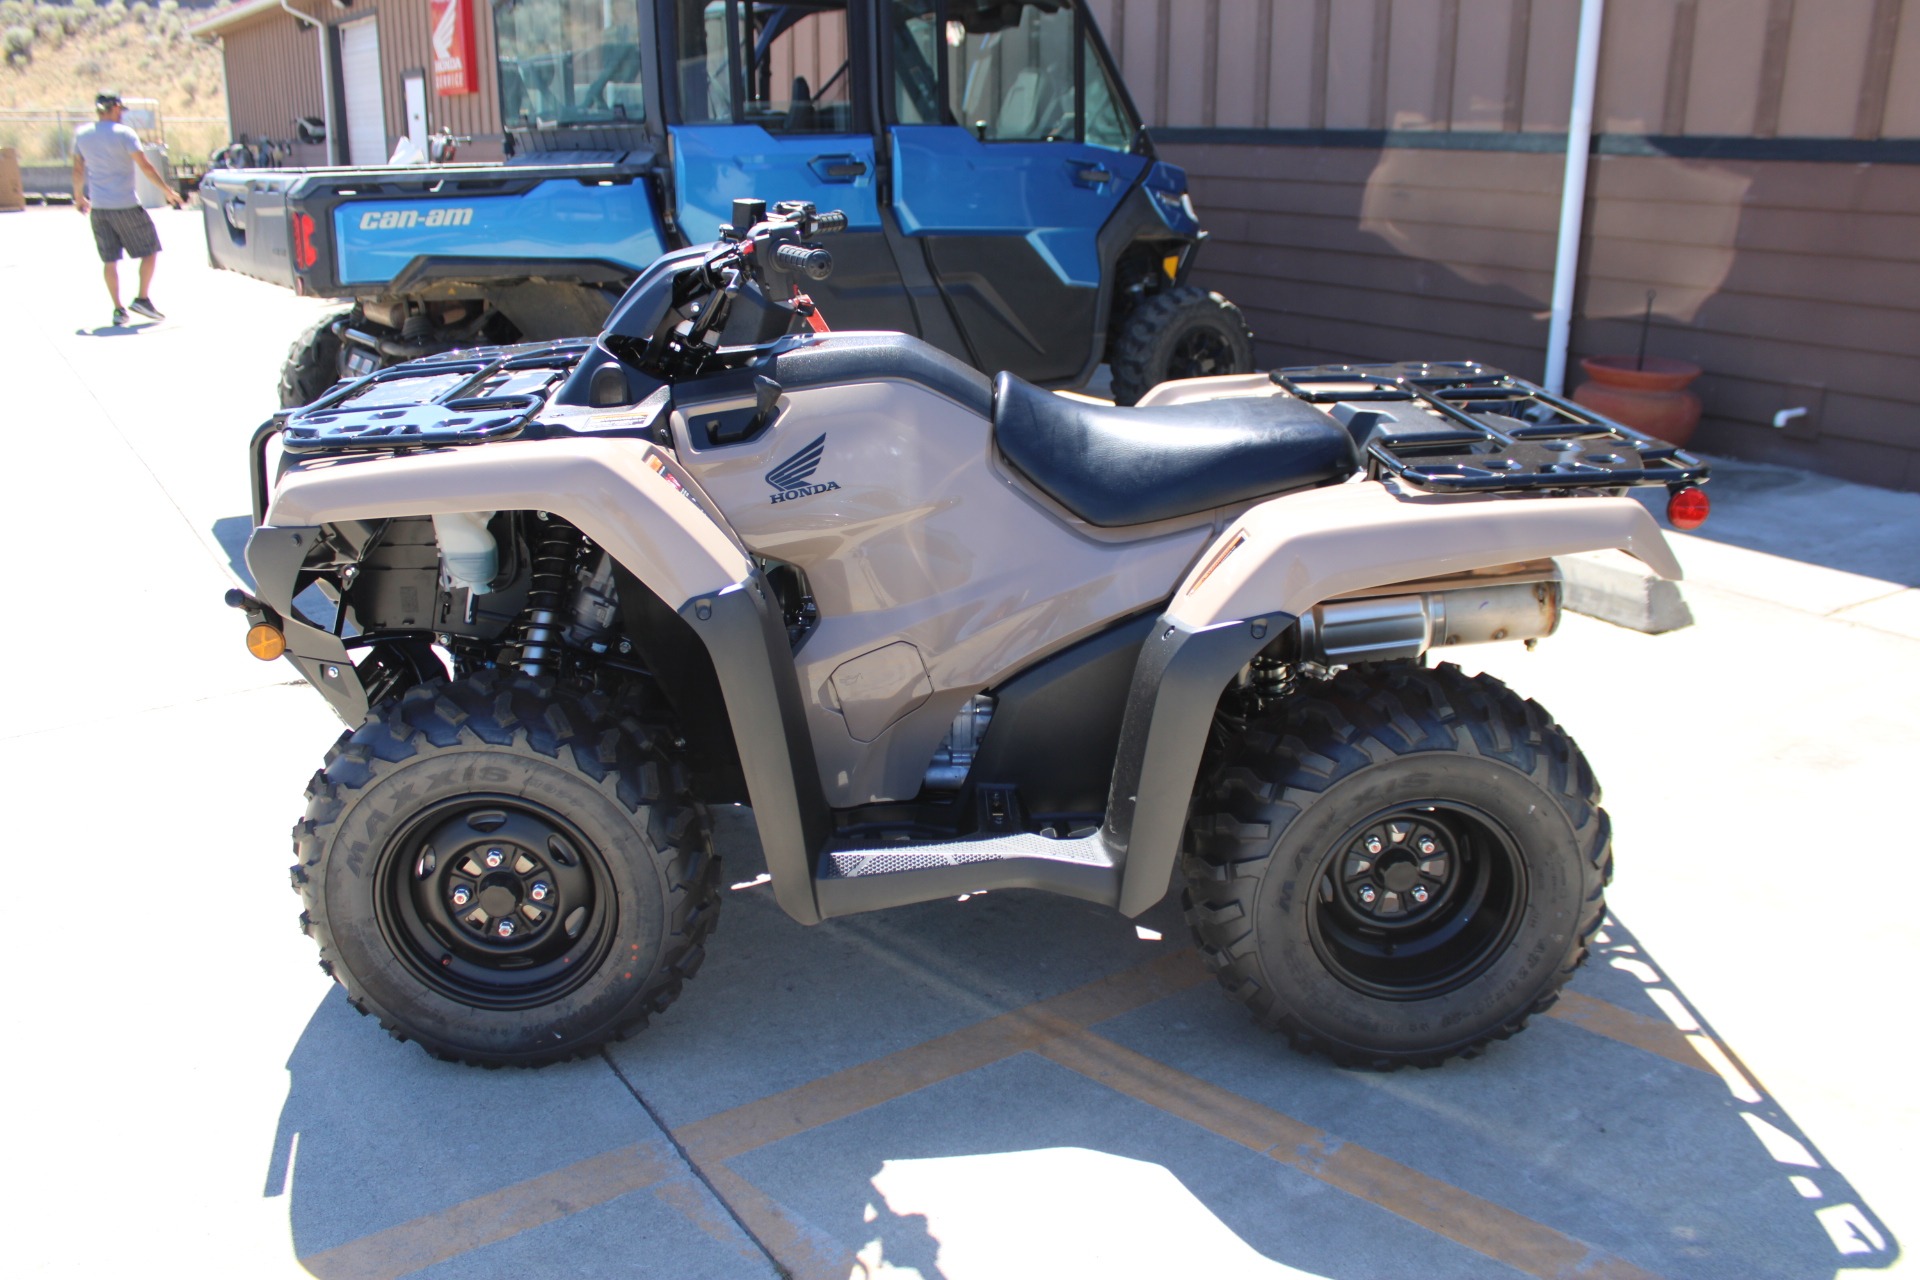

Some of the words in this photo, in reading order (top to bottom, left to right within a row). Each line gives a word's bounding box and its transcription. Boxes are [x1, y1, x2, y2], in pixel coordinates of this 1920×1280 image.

[359, 207, 474, 231] can-am
[769, 481, 842, 505] HONDA
[345, 766, 510, 879] MAXXIS
